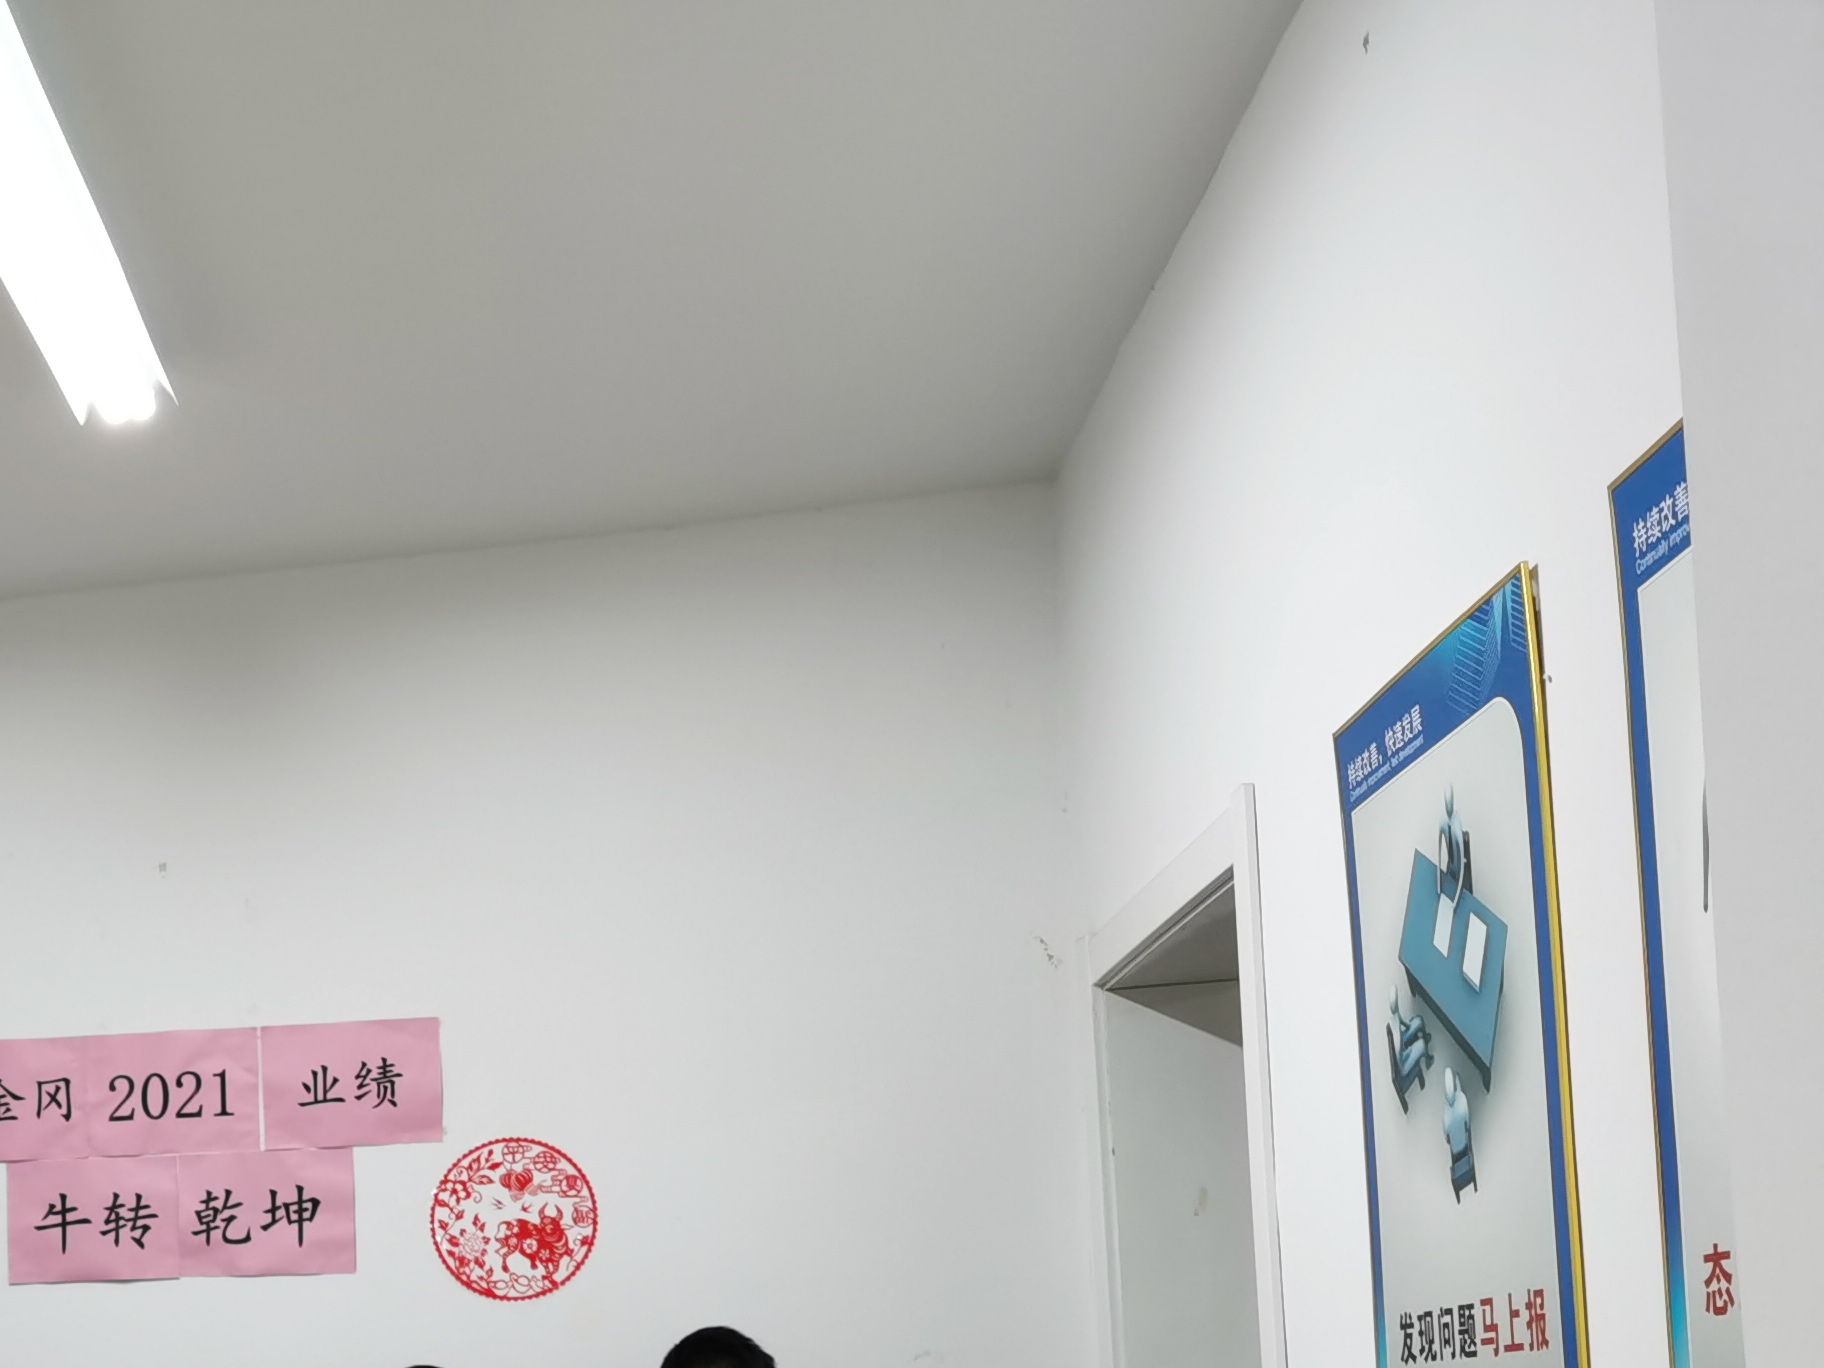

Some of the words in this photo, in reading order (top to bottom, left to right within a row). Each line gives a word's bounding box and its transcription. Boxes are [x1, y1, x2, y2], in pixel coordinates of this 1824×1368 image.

[107, 1069, 235, 1123] 2021
[297, 1056, 404, 1110] 业绩
[1703, 1243, 1734, 1316] 态
[1400, 1289, 1550, 1365] 发现问题马上报
